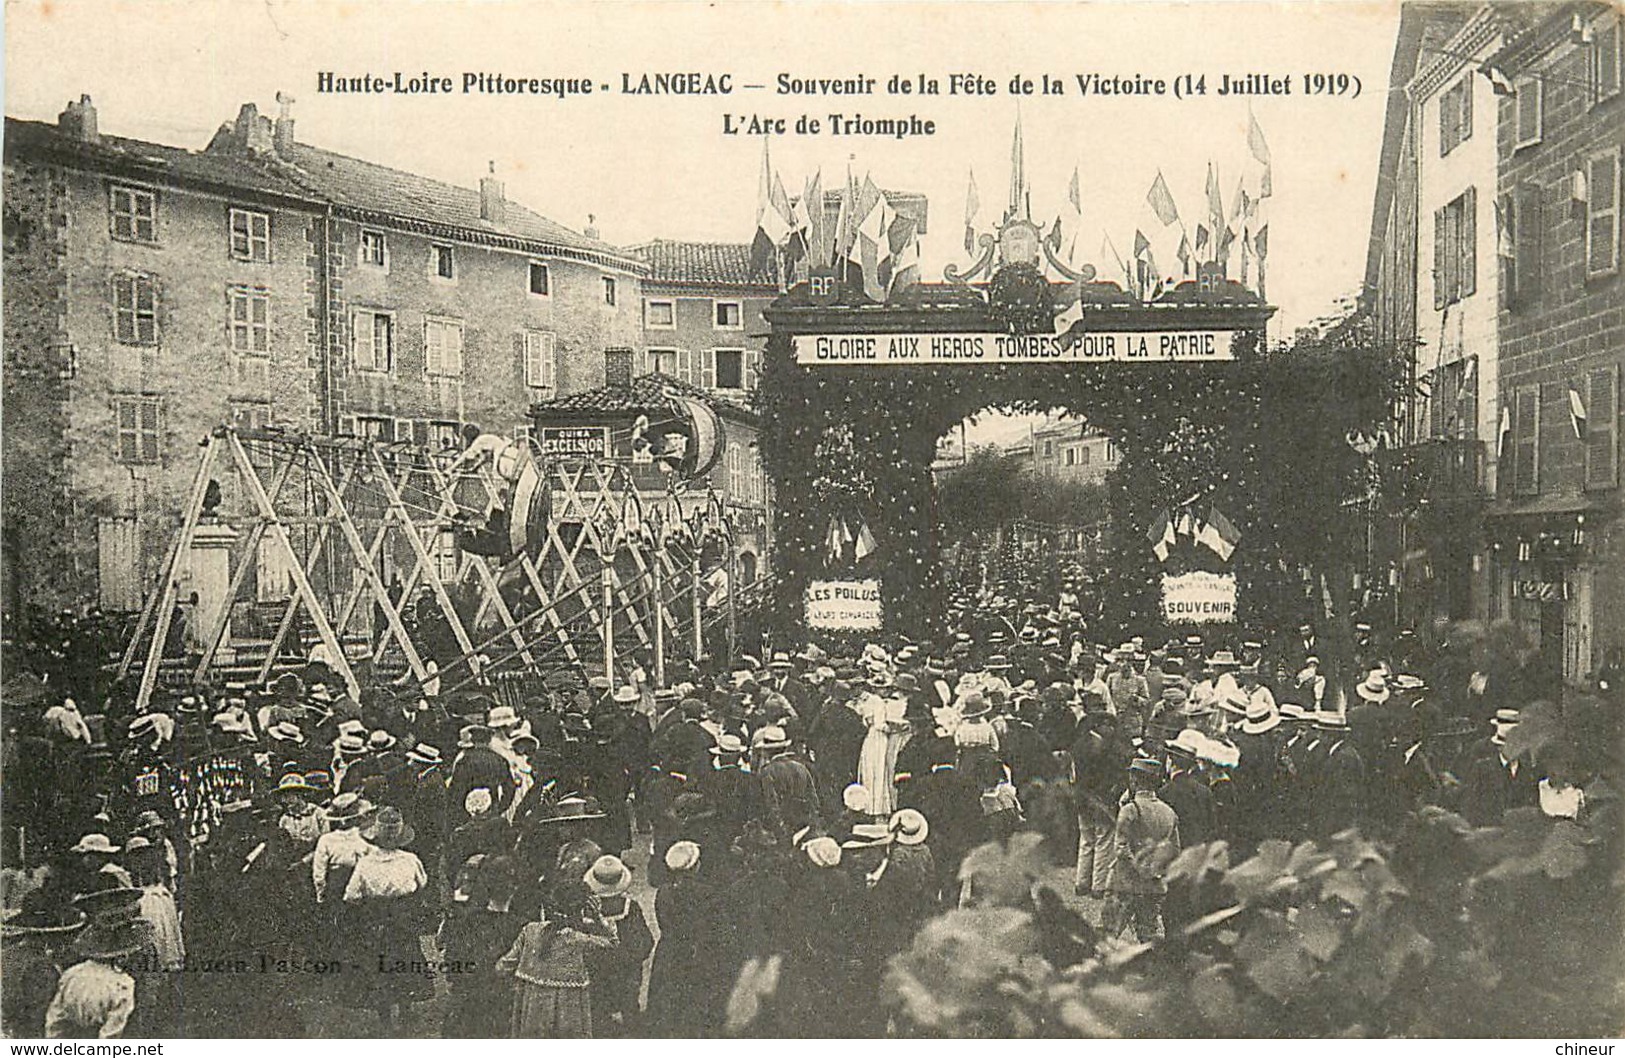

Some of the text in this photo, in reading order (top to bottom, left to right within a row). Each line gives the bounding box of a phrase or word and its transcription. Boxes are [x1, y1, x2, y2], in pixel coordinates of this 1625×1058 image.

[811, 276, 833, 296] RF
[888, 337, 919, 359] AUX
[931, 337, 985, 359] HEROS
[995, 336, 1061, 358] TOMBES
[1073, 336, 1116, 358] POUR
[1126, 336, 1149, 357] LA
[1160, 335, 1214, 356] PATRIE
[835, 586, 879, 602] POILUS
[1168, 601, 1231, 614] SOUVENIR
